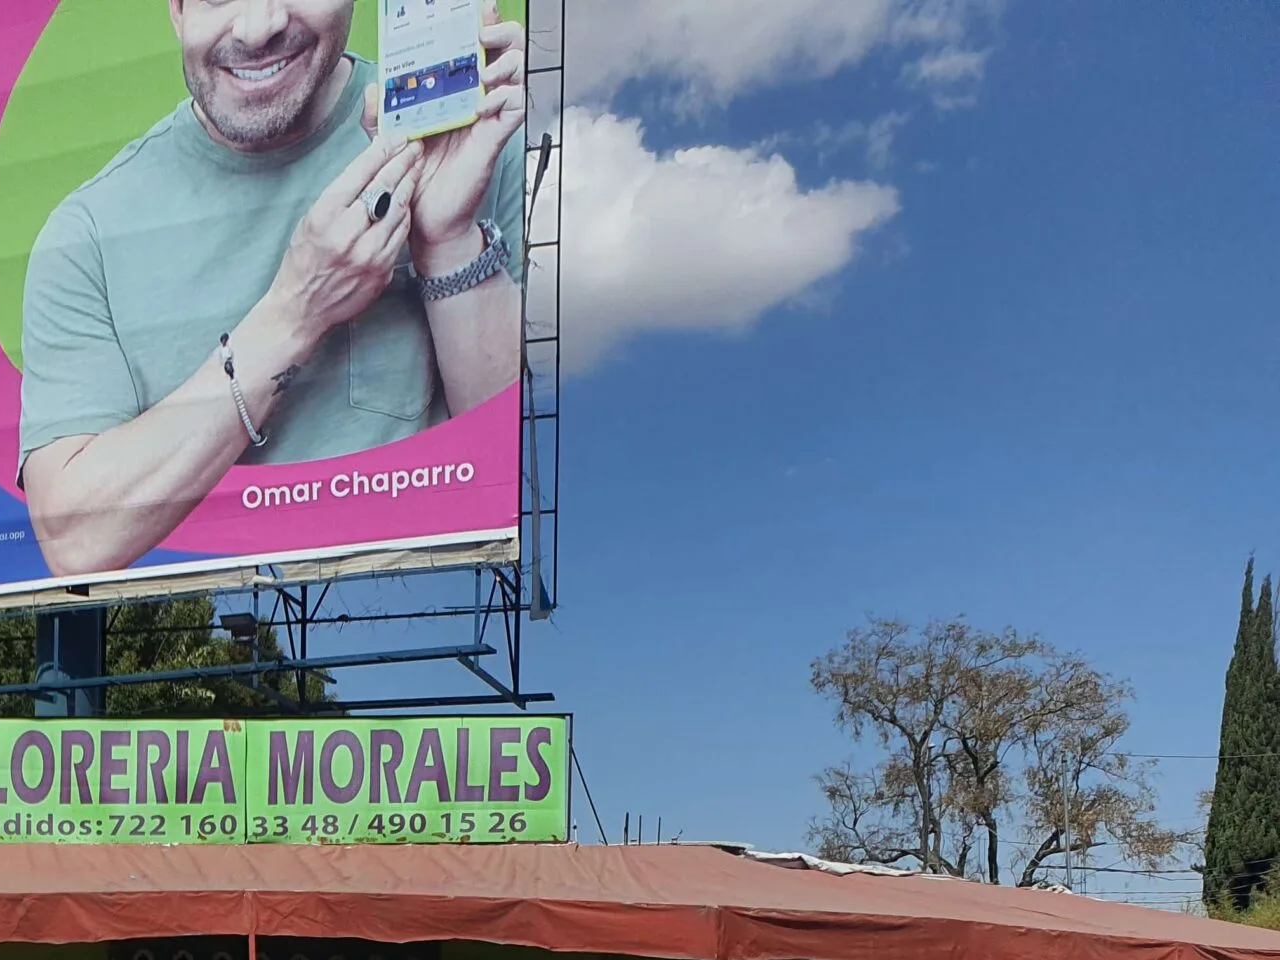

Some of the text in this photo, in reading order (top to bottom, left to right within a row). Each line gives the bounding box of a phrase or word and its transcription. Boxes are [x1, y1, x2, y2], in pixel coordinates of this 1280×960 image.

[242, 462, 474, 508] Omar Chaparro
[267, 727, 552, 805] MORALES
[180, 814, 237, 836] 160
[252, 815, 289, 837] 33
[440, 812, 476, 833] 15
[488, 811, 527, 833] 26
